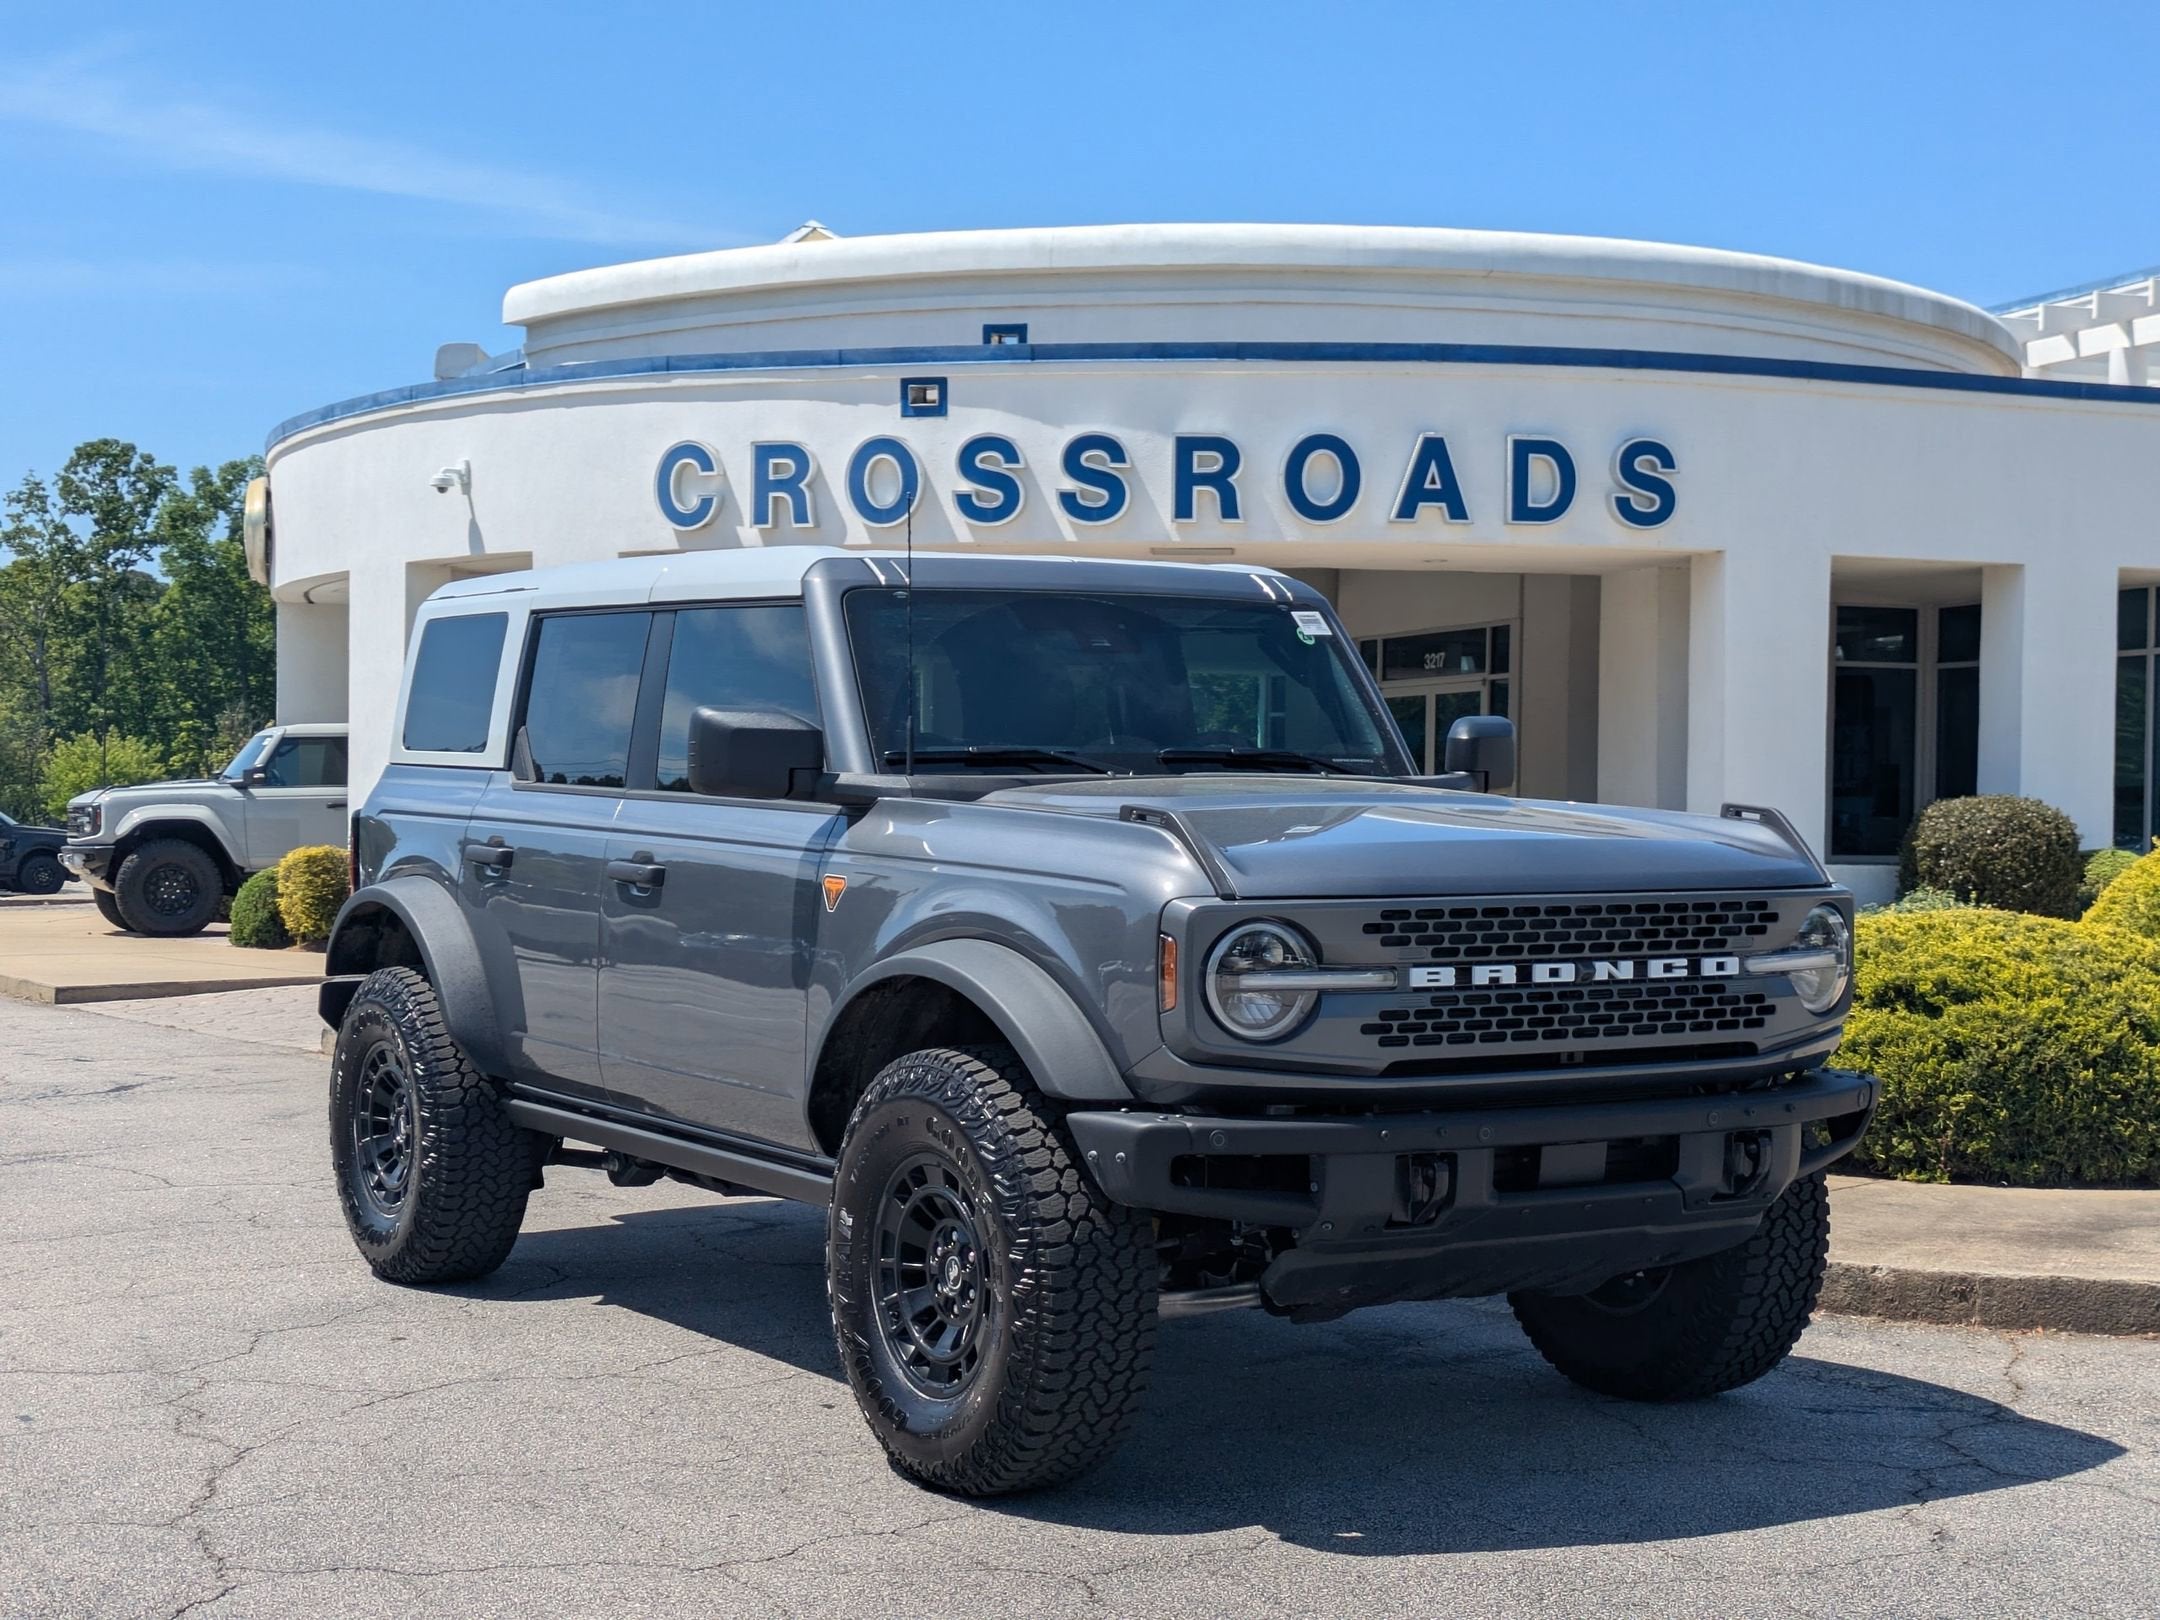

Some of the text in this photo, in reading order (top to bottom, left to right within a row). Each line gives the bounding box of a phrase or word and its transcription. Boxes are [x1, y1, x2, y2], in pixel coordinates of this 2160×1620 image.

[654, 433, 1679, 530] CROSSROADS
[1423, 652, 1446, 670] 3217
[1409, 956, 1740, 988] BRONCO
